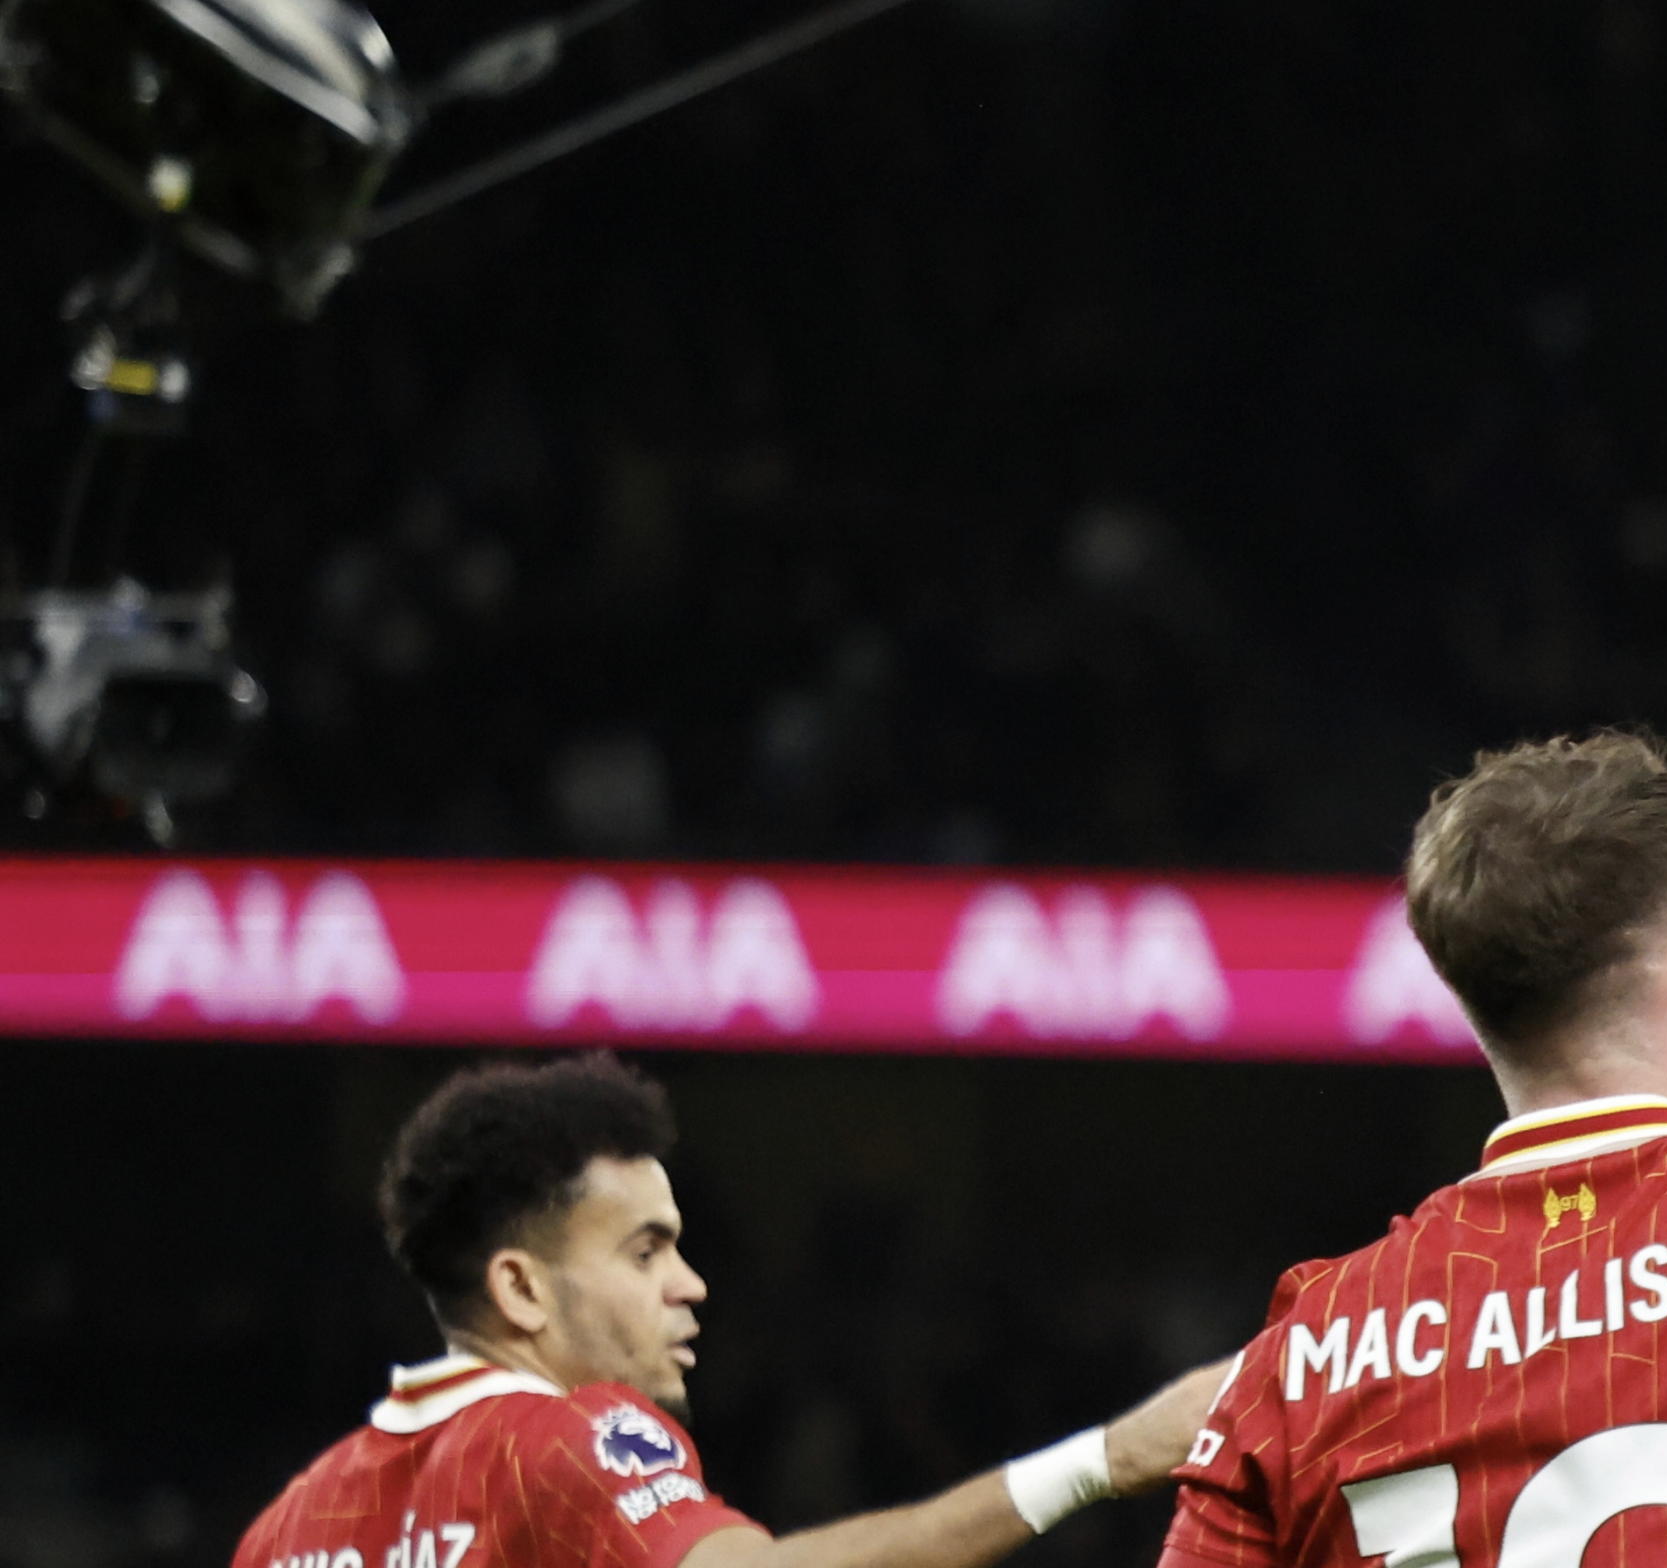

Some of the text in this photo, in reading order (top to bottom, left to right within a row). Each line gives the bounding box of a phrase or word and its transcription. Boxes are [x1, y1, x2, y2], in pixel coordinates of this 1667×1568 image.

[113, 869, 406, 1026] AIA
[525, 875, 820, 1031] AIA
[935, 884, 1229, 1043] AIA
[1285, 1299, 1448, 1401] MAC
